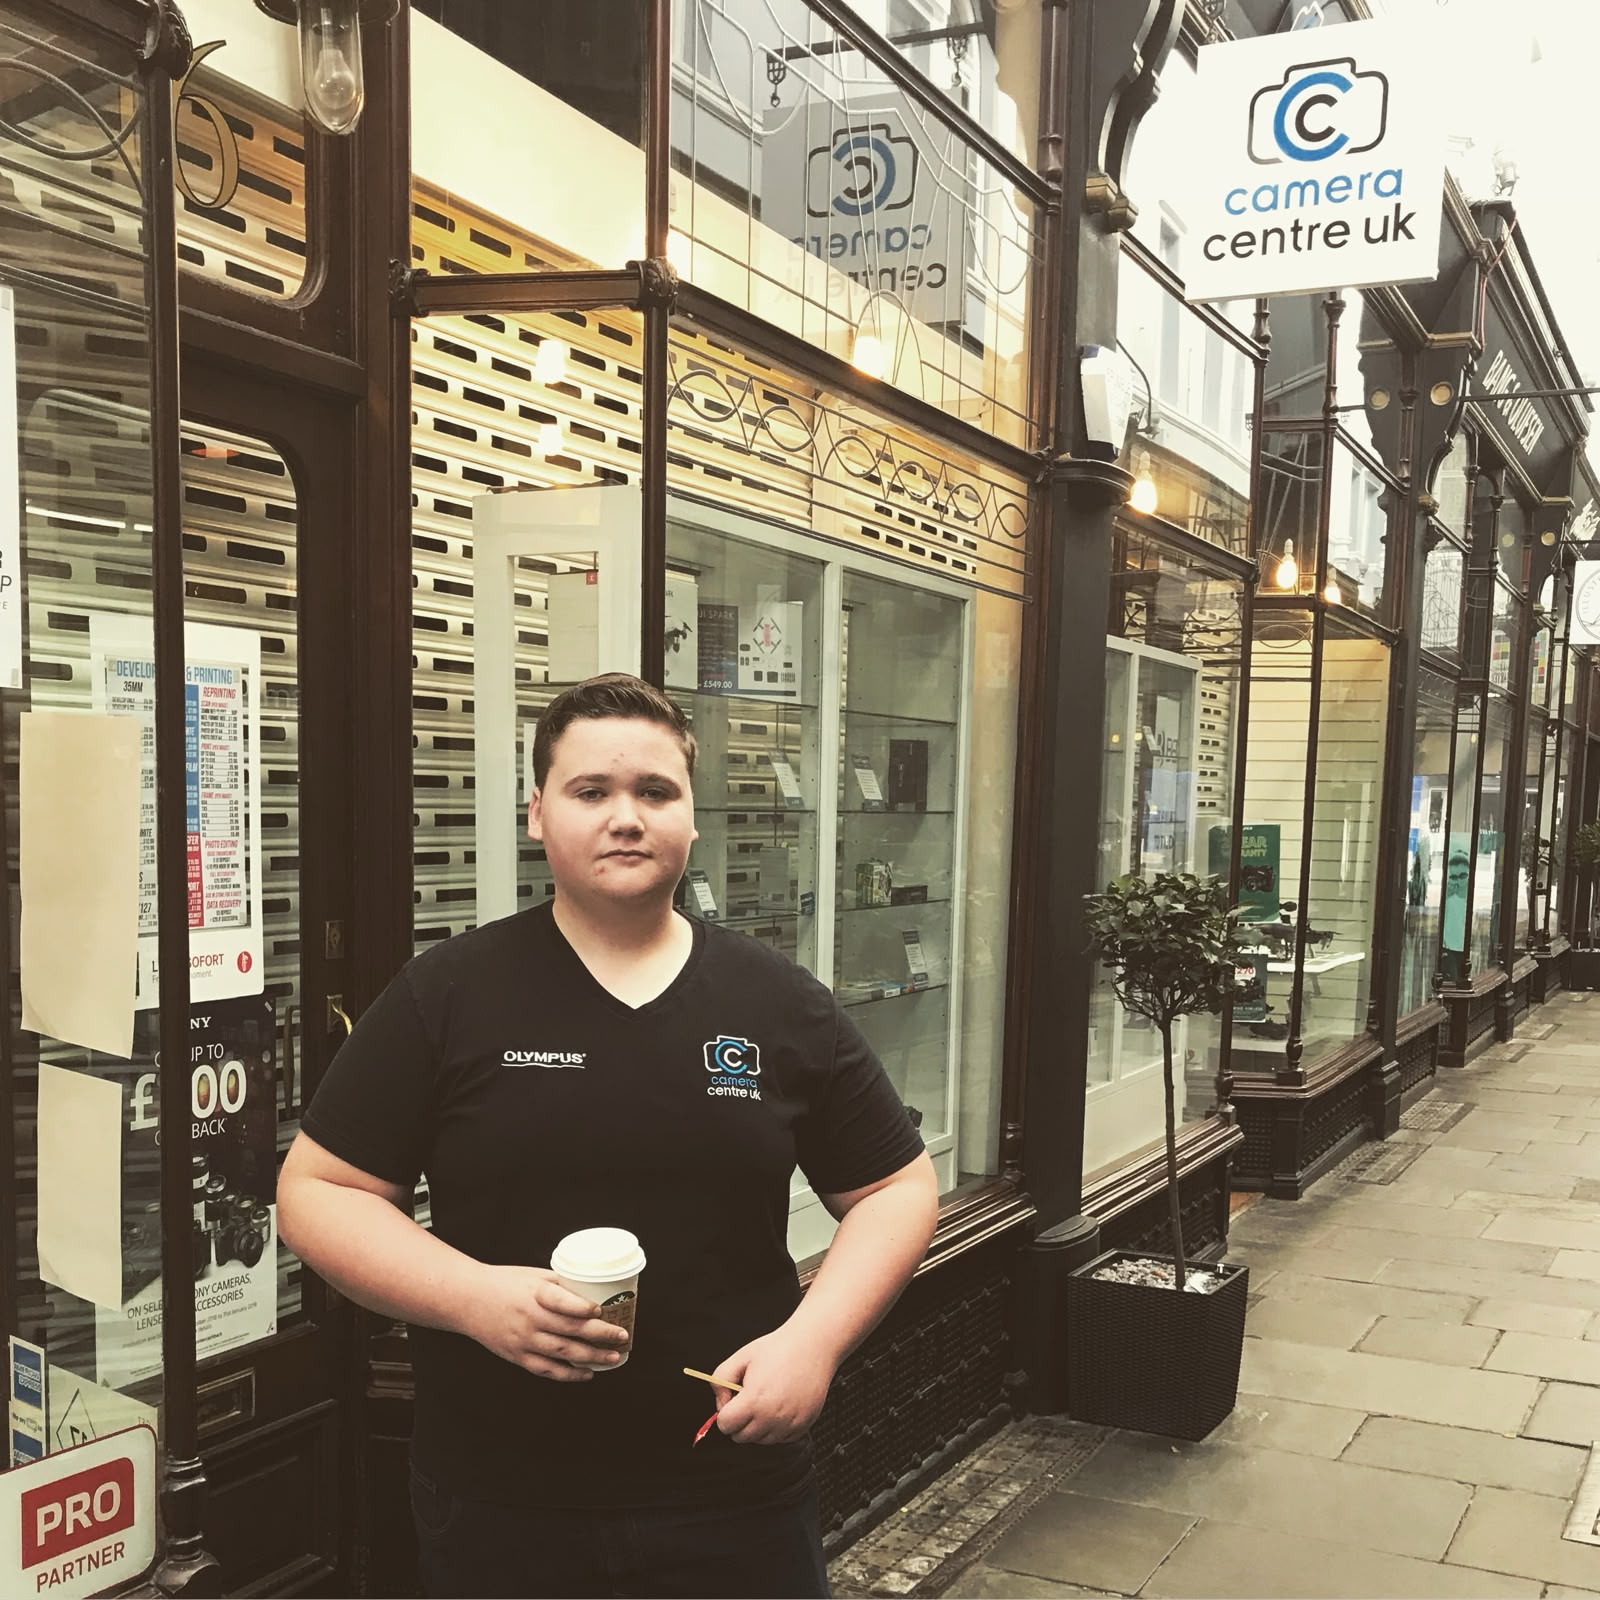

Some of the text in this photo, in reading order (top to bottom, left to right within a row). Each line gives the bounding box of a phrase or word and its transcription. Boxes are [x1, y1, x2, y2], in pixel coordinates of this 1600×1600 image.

[1224, 168, 1403, 215] camera
[1203, 202, 1417, 261] centre uk
[1482, 349, 1517, 409] BANG
[1507, 396, 1545, 456] OLUFSEN
[708, 610, 735, 620] SPARK
[186, 666, 192, 682] &
[194, 667, 232, 684] PRINTING
[123, 681, 143, 693] 35MM
[703, 680, 733, 689] £549.00
[203, 686, 236, 699] REPRINTING
[205, 839, 239, 848] PHOTO EDITING
[1241, 836, 1267, 849] EAR
[139, 902, 152, 914] 127
[206, 899, 241, 909] DATA RECOVERY
[190, 1016, 212, 1030] NY
[207, 1043, 224, 1060] TO
[503, 1050, 584, 1064] OLYMPUS
[711, 1076, 757, 1088] camera
[707, 1086, 761, 1101] centre uk
[192, 1118, 228, 1139] BACK
[127, 1273, 252, 1319] ON SELE ONY CAMERAS,
[136, 1288, 244, 1331] LENSE CCESSORIES
[14, 1361, 41, 1381] AMERICAN
[36, 1481, 121, 1547] PRO
[37, 1541, 125, 1594] PARTNER
